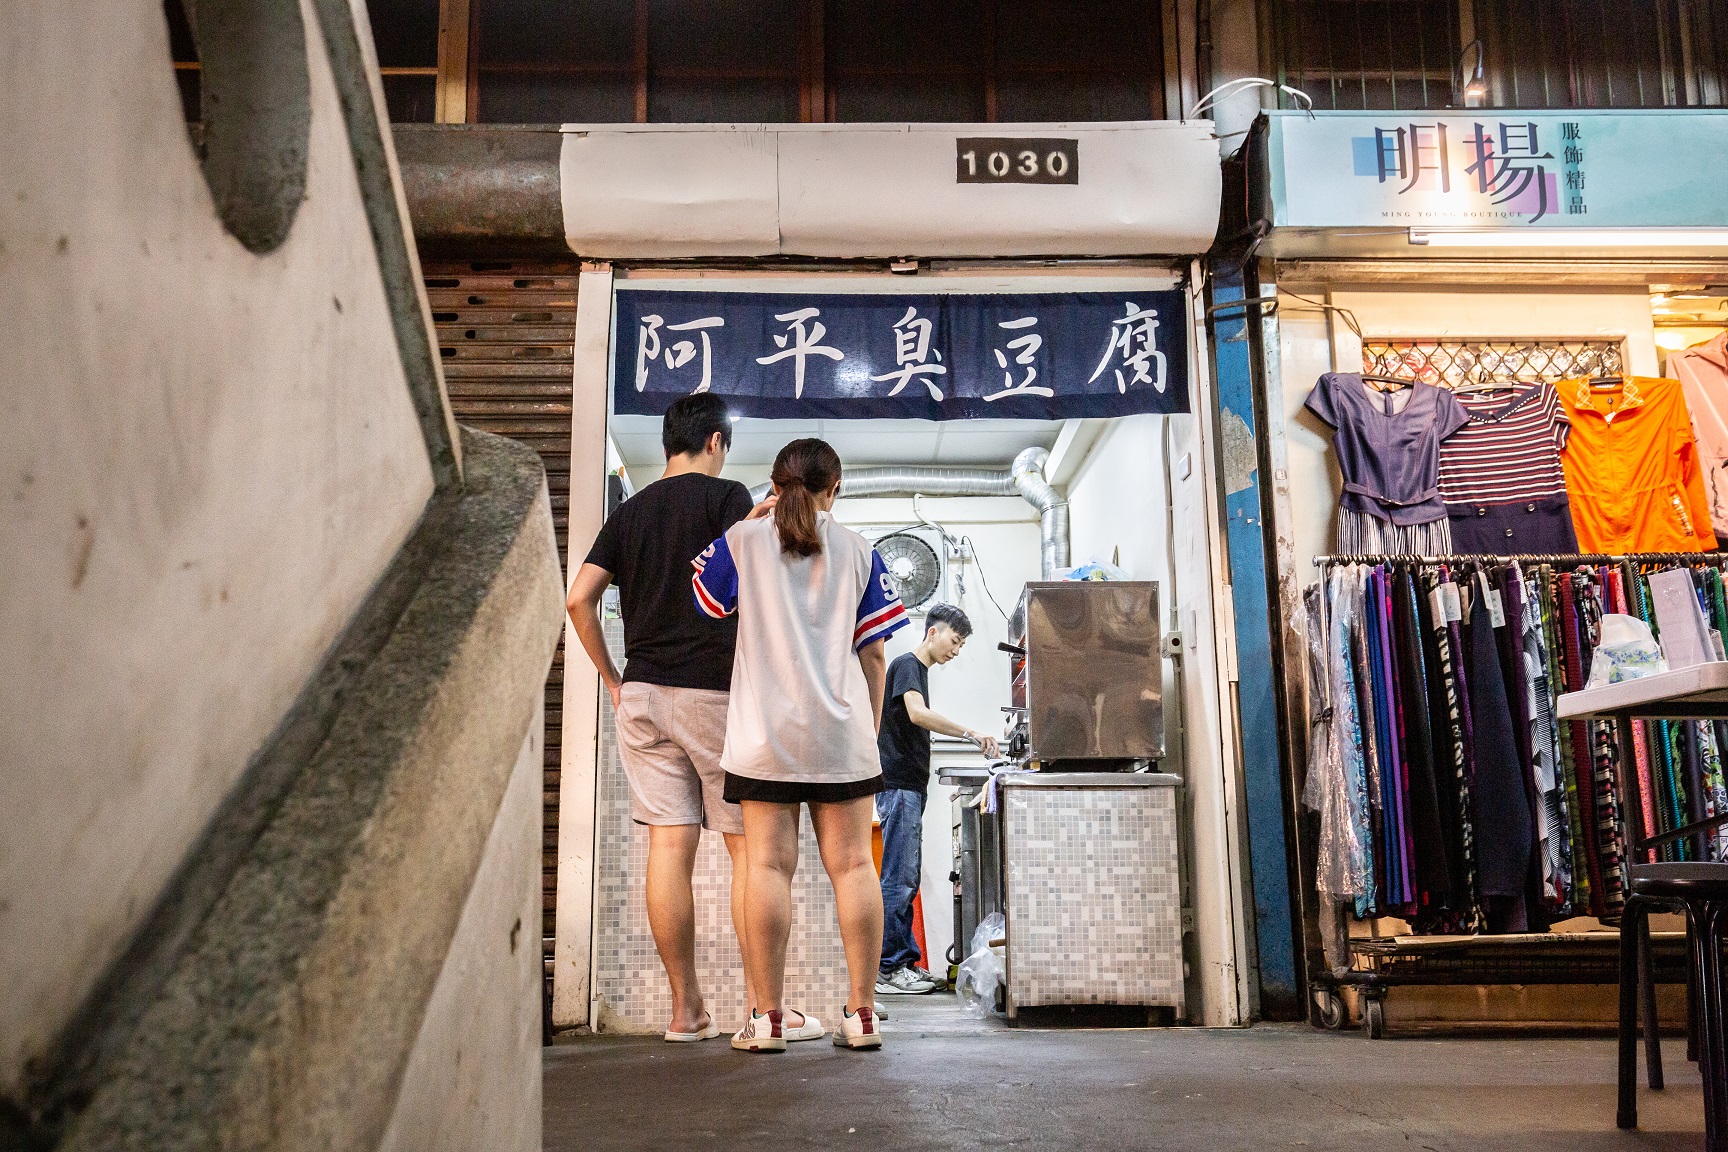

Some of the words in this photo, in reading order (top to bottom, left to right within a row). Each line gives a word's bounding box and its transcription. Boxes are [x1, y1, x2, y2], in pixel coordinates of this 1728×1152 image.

[962, 150, 1069, 177] 1030
[1374, 121, 1555, 224] 明揚
[1562, 122, 1588, 215] 服飾精品
[1463, 211, 1523, 219] BOUTIQUE
[635, 301, 1168, 402] 阿平臭豆腐
